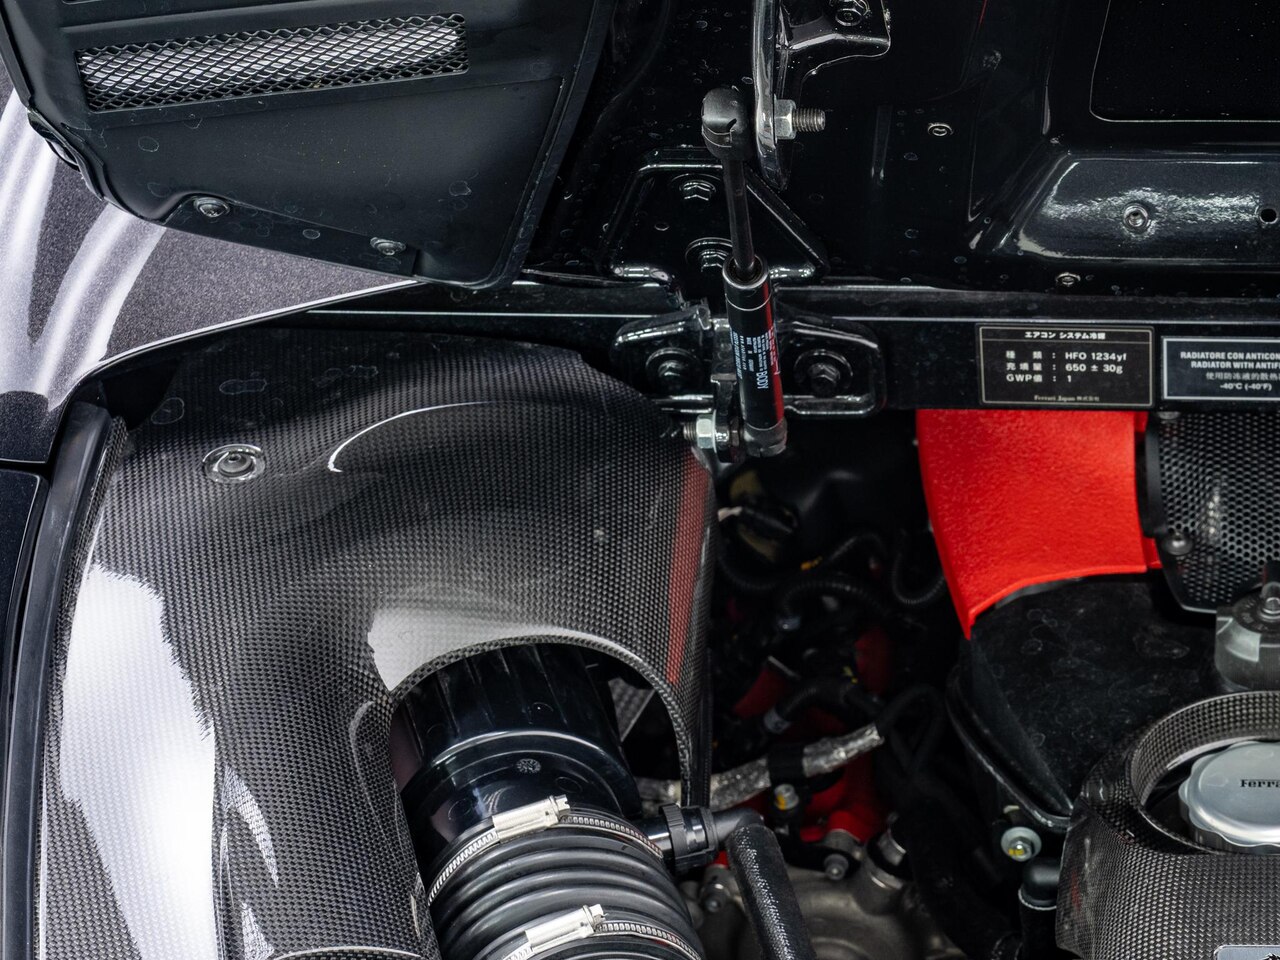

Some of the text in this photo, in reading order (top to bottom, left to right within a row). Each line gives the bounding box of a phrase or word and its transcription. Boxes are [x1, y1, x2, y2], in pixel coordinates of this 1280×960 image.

[1024, 331, 1056, 339] エアコン
[1065, 352, 1087, 360] HFO
[1091, 352, 1127, 362] 1234yf
[1180, 351, 1226, 359] RADIATORE
[1227, 352, 1244, 360] CON
[1065, 364, 1086, 372] 650
[1103, 364, 1123, 374] 30g
[1190, 361, 1231, 369] RADIATOR
[1233, 361, 1254, 369] WITH
[756, 370, 769, 389] BODY
